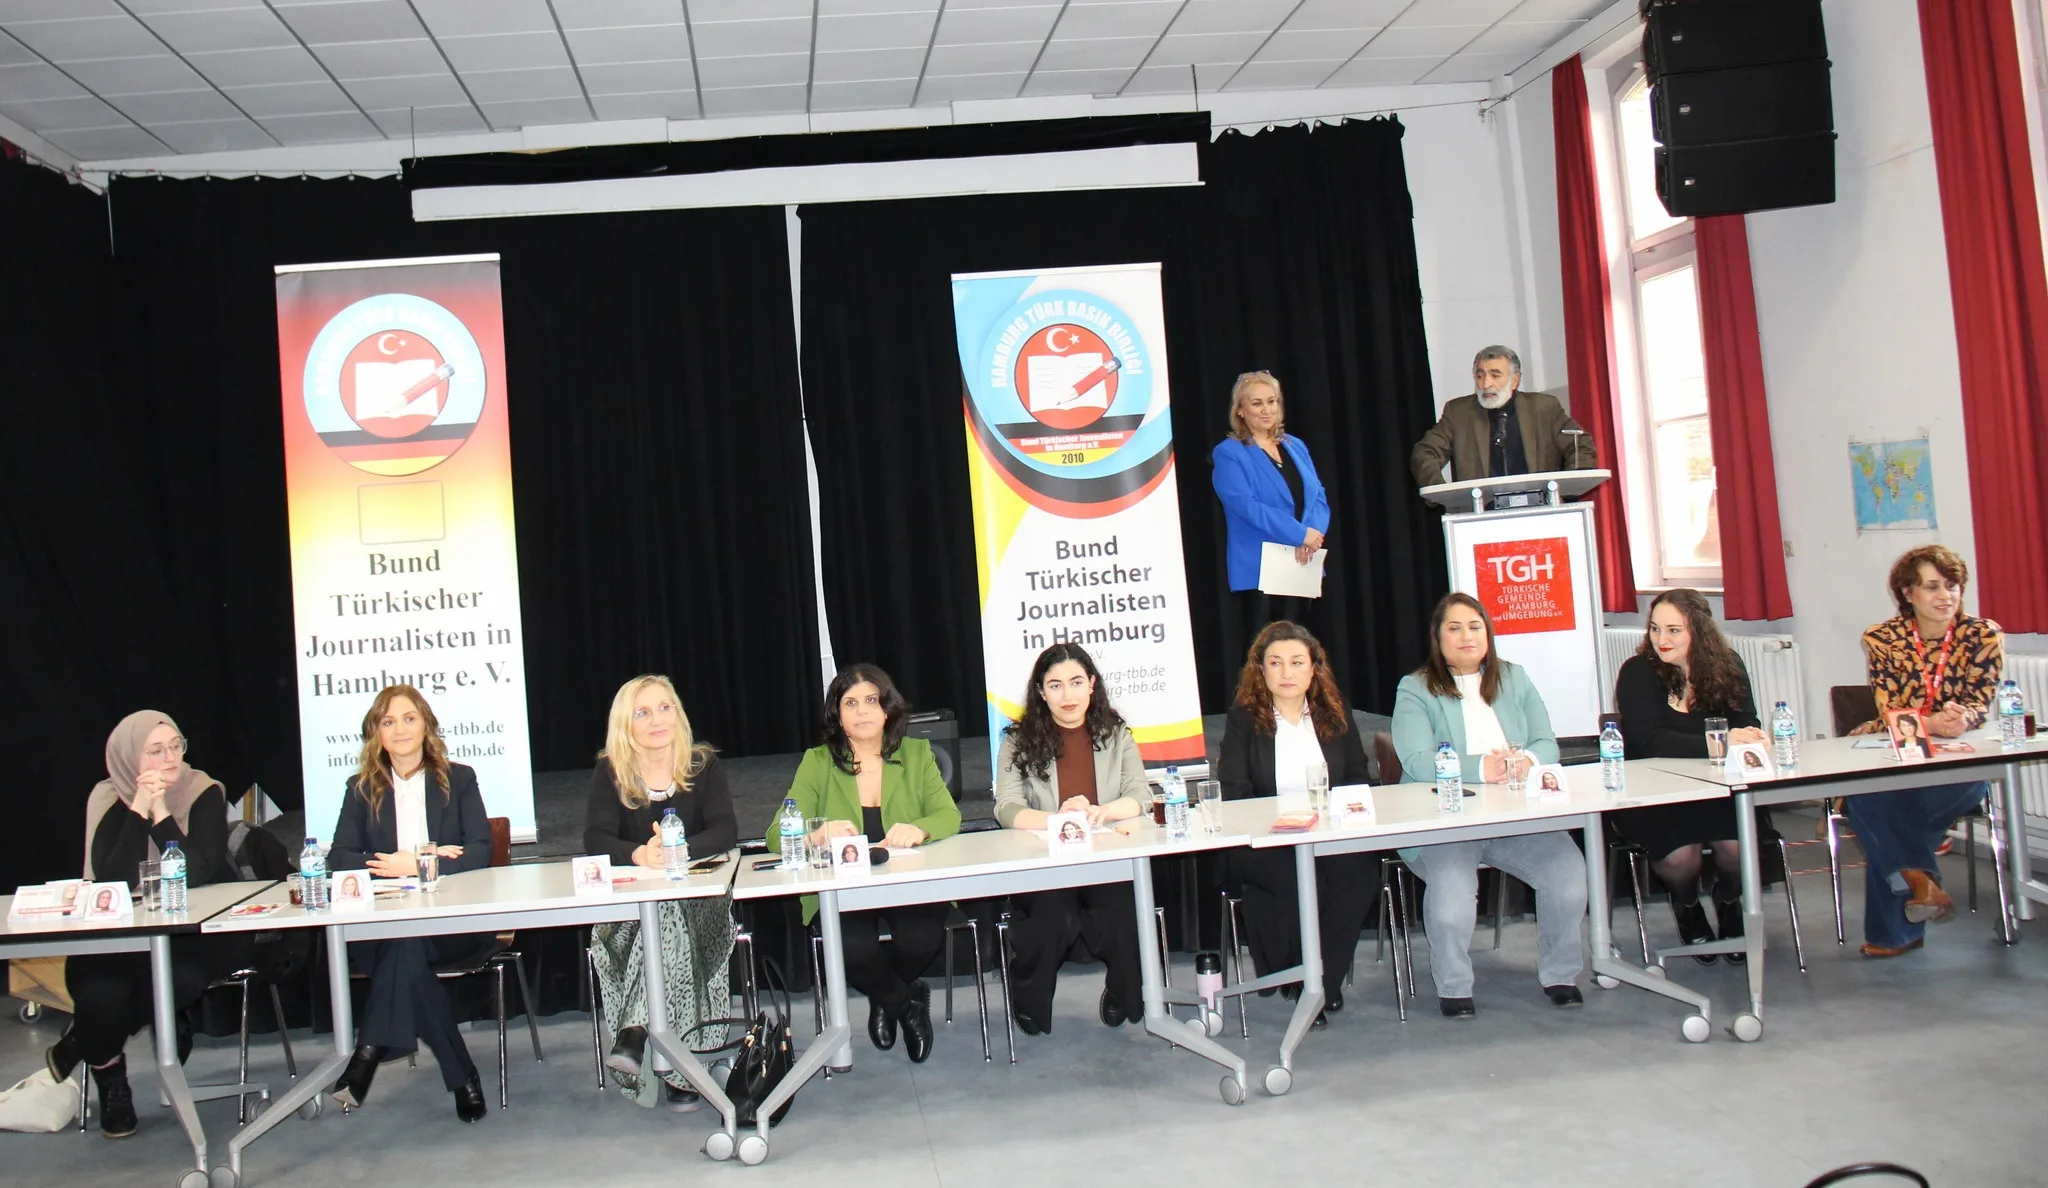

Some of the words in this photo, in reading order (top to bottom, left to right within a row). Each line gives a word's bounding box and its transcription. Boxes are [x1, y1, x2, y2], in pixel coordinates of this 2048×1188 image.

[1061, 452, 1084, 464] 2010
[1055, 535, 1119, 560] Bund
[368, 549, 441, 575] Bund
[1486, 553, 1554, 583] TGH
[1025, 564, 1152, 591] Türkischer
[1501, 583, 1550, 594] TÜRKISCHE
[329, 588, 483, 617] Türkischer
[1016, 593, 1166, 621] Journalisten
[1497, 592, 1547, 604] GEMEINDE
[1508, 600, 1555, 611] HAMBURG
[1502, 609, 1553, 621] UMGEBUNG
[305, 628, 476, 658] Journalisten
[487, 623, 512, 646] in
[1022, 630, 1045, 650] in
[1052, 622, 1166, 645] Hamburg
[312, 669, 447, 697] Hamburg
[455, 668, 476, 687] e.
[485, 661, 511, 684] V.
[1102, 664, 1165, 683] urg-tbb.de
